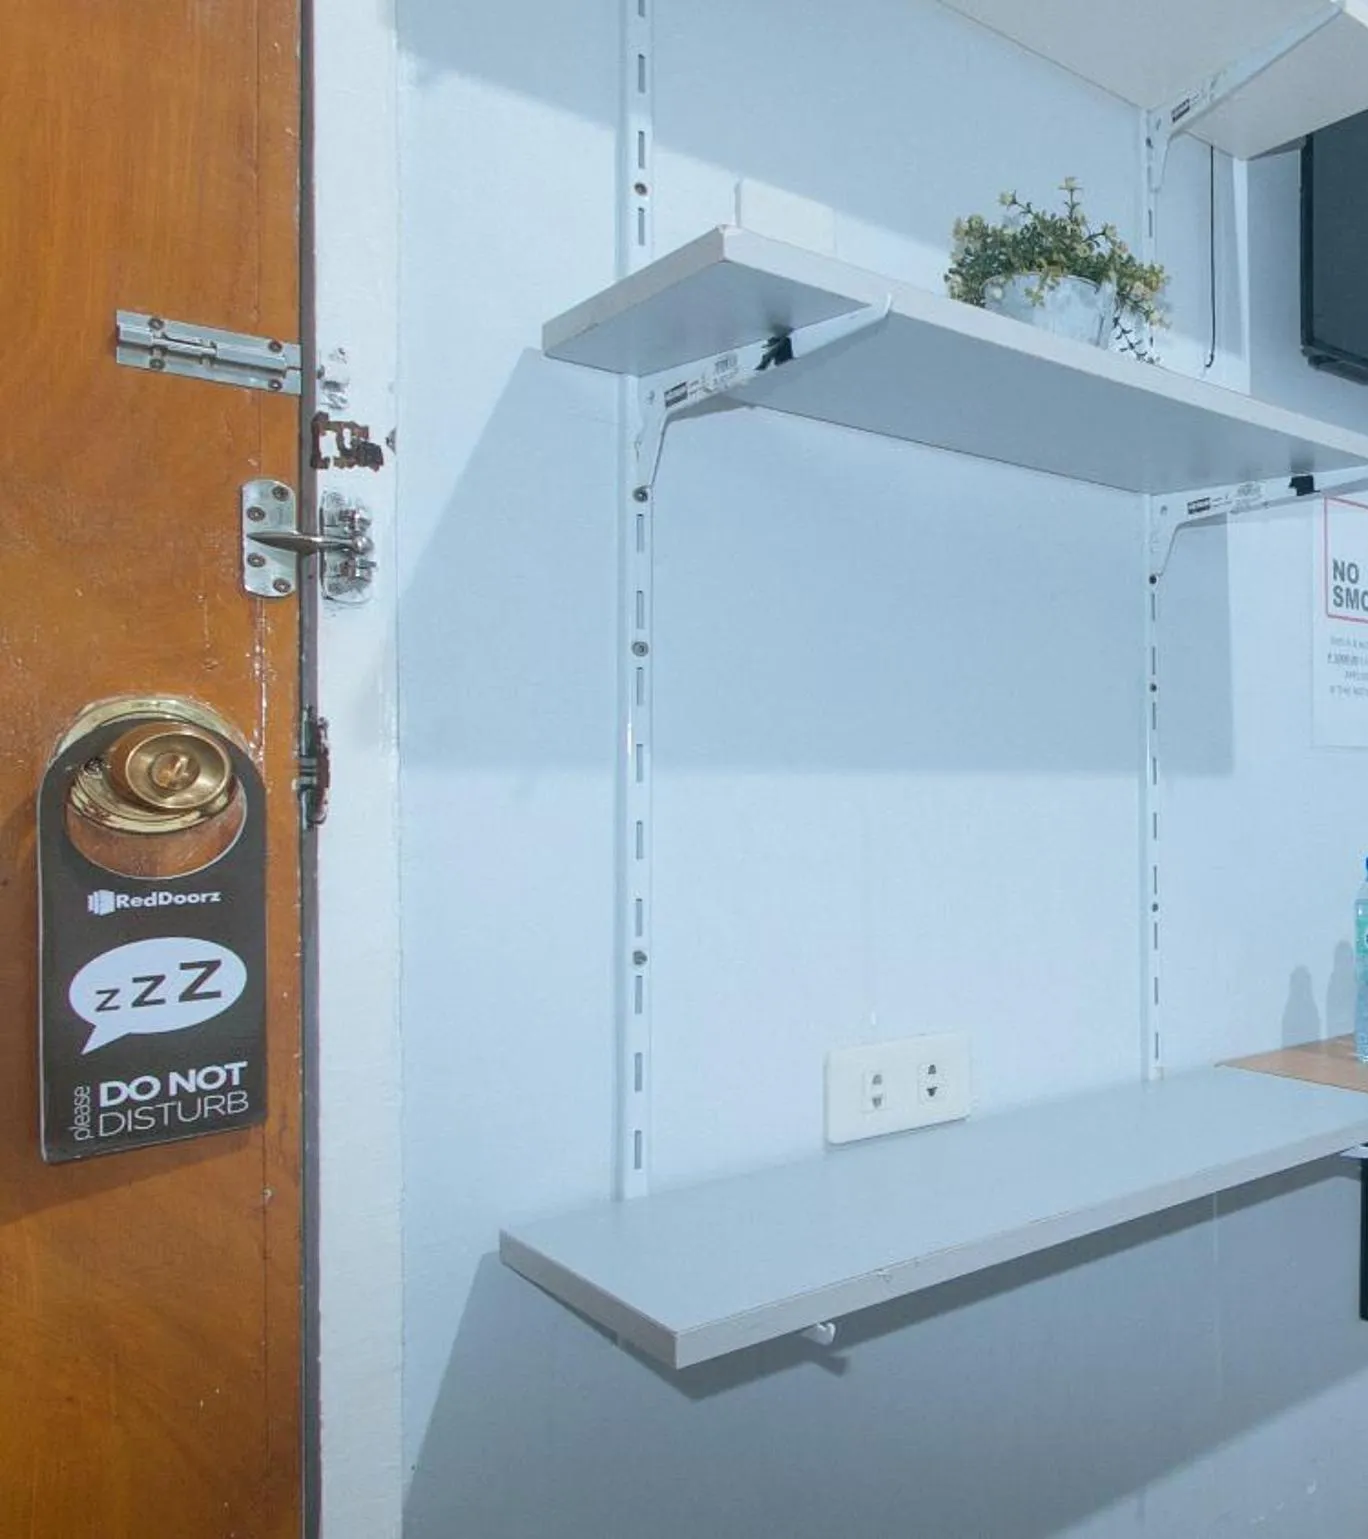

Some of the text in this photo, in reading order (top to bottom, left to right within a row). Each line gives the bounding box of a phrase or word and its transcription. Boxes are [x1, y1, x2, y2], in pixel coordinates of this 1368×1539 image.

[1332, 558, 1360, 584] NO
[115, 891, 221, 909] RedDoorz
[100, 1061, 248, 1107] DO NOT
[74, 1086, 95, 1141] please
[100, 1091, 249, 1137] DISTURB
